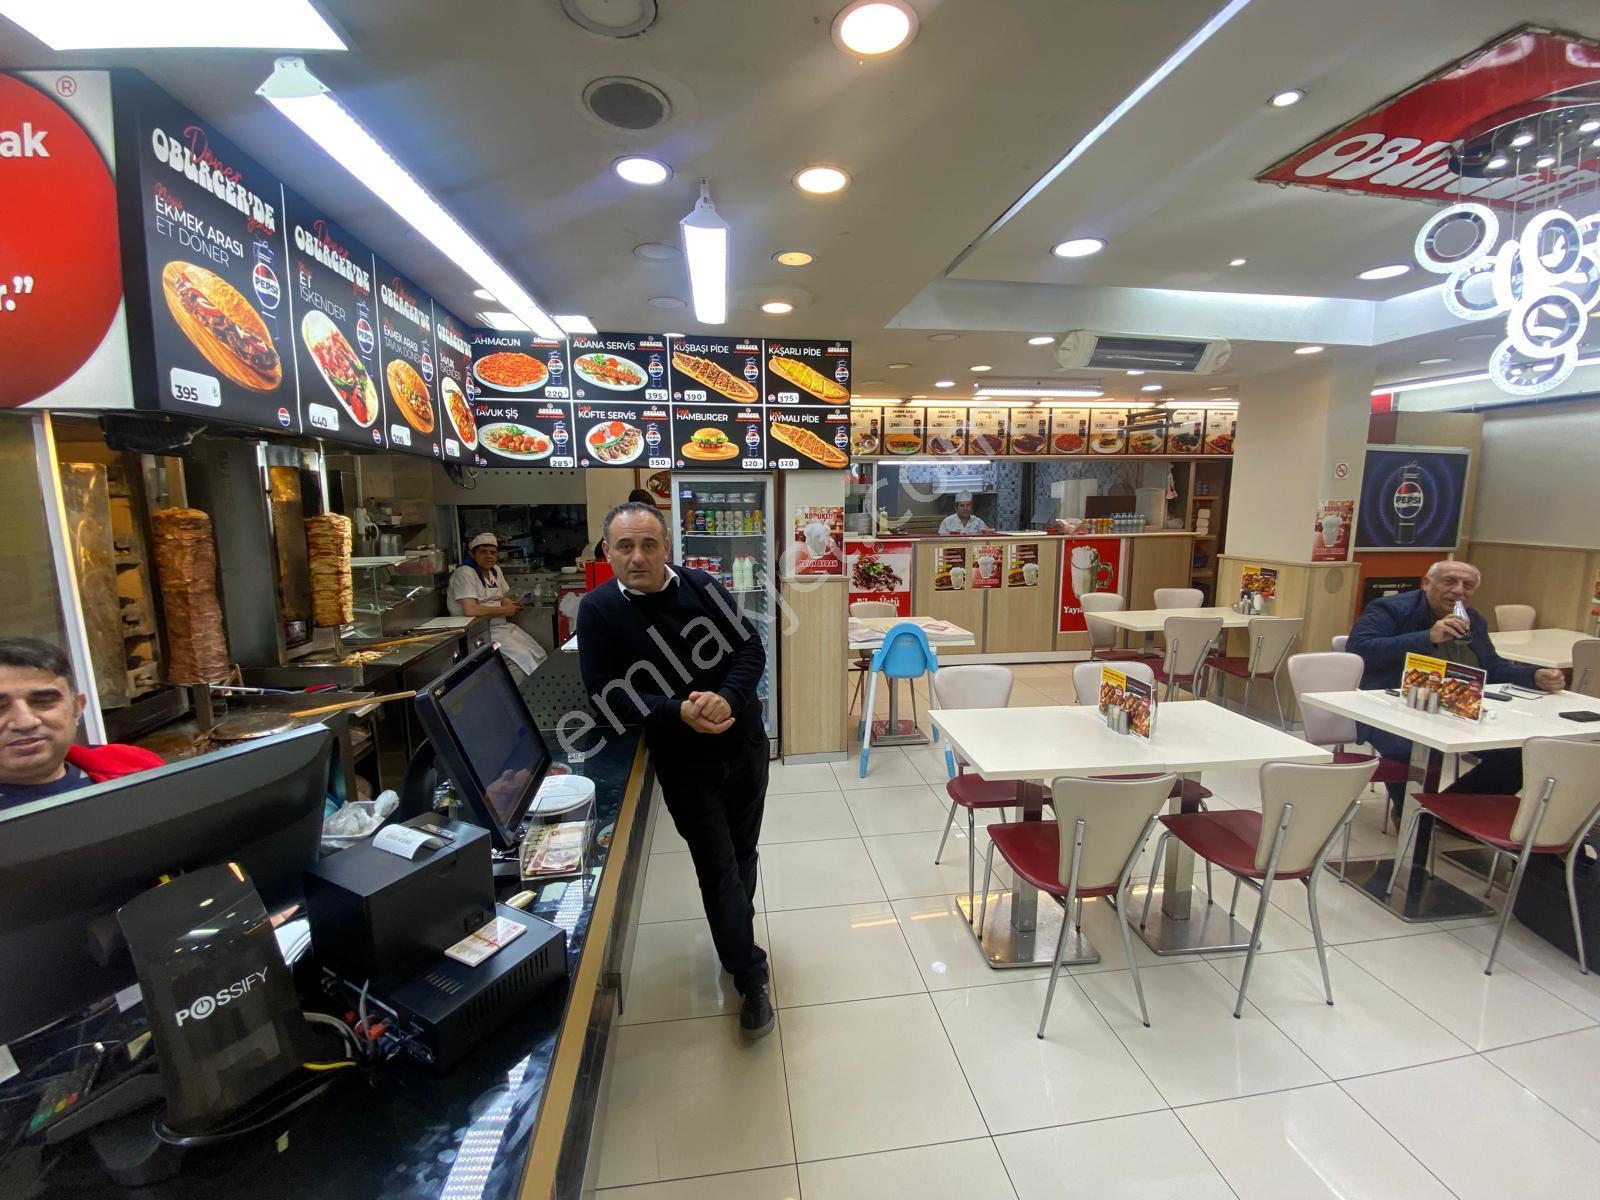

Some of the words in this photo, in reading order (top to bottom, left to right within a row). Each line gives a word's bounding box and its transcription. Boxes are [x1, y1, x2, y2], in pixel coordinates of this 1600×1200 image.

[152, 128, 275, 232] OBURGER'DE
[155, 195, 204, 236] EKMEK
[207, 226, 244, 258] ARASI
[156, 216, 174, 238] ET
[178, 227, 230, 268] DÖNER
[299, 271, 313, 289] ET
[254, 277, 280, 296] PEPSI
[573, 340, 605, 349] ADANA
[606, 341, 636, 351] SERVİS
[673, 343, 709, 354] KUŞBAŞI
[710, 343, 730, 354] PİDE
[768, 347, 802, 357] KAŞARLI
[803, 346, 822, 357] PİDE
[174, 384, 199, 401] 395
[647, 392, 663, 400] 395
[476, 408, 504, 417] TAVUK
[505, 407, 519, 419] ŞİŞ
[607, 410, 637, 420] SERVİS
[676, 412, 729, 422] HAMBURGER
[769, 414, 800, 422] KIYMALI
[801, 413, 820, 423] PİDE
[311, 415, 328, 428] 440
[1395, 495, 1421, 505] PEPSI
[175, 966, 268, 1027] POSSIFY
